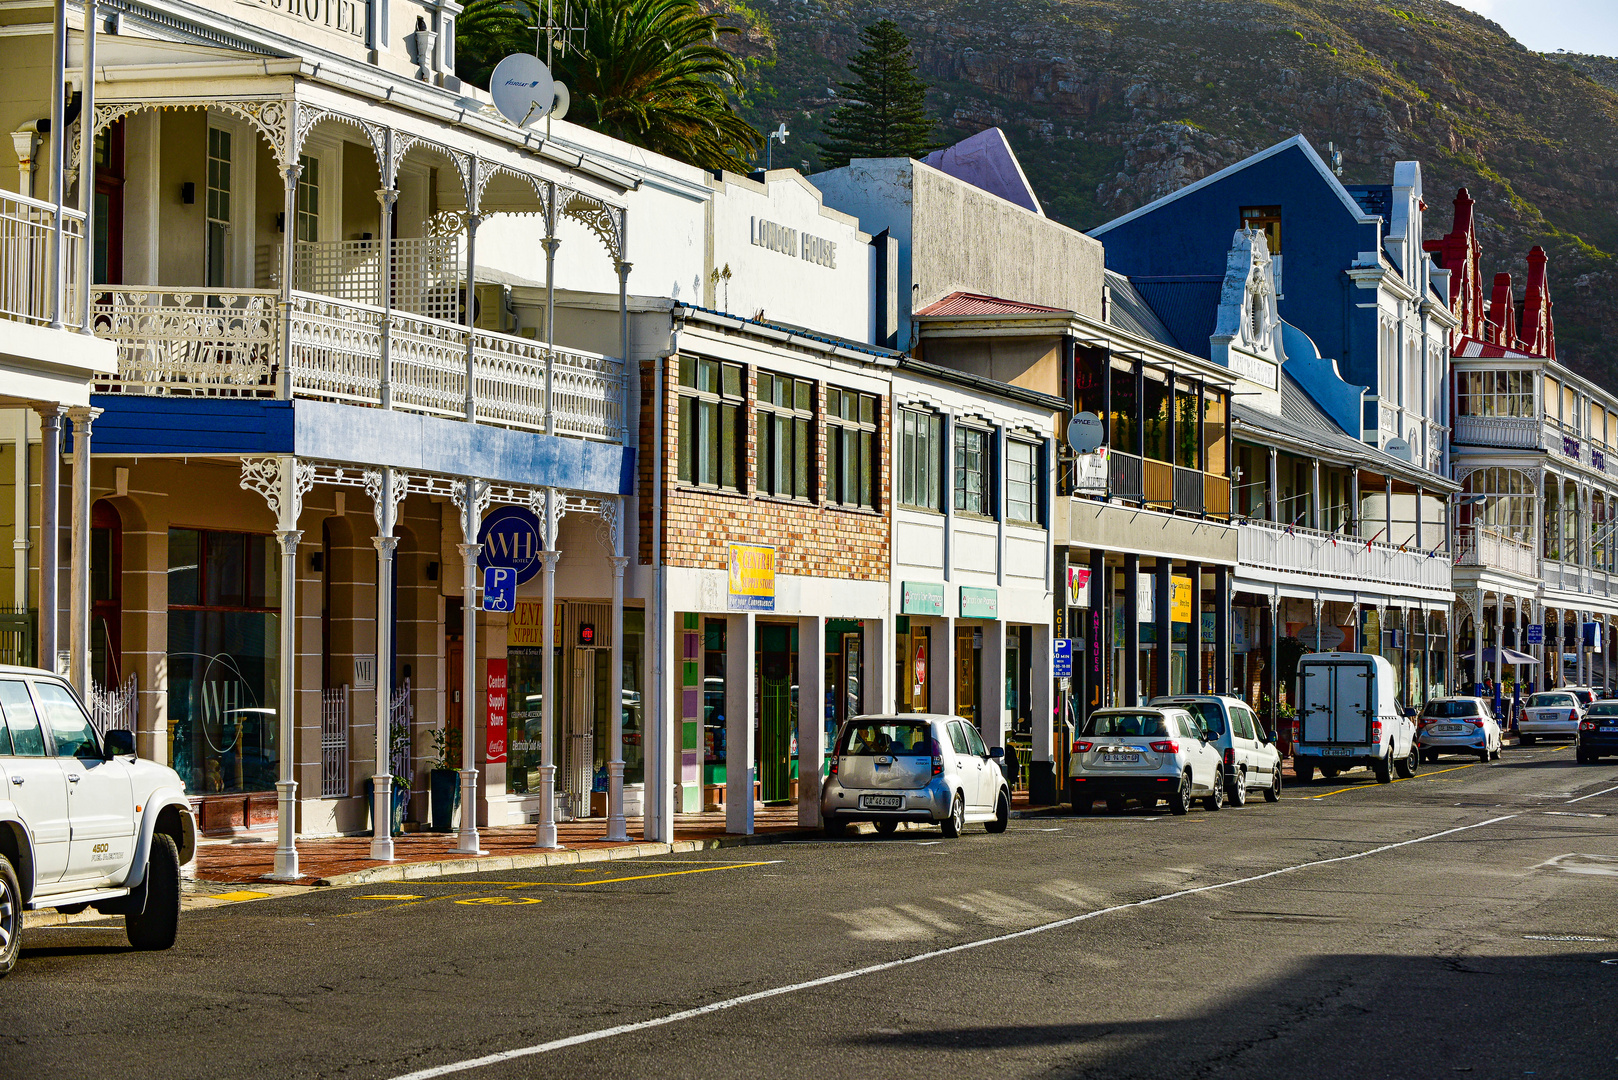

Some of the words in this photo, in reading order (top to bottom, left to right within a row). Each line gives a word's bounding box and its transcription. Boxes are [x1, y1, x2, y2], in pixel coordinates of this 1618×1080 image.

[751, 215, 798, 257] LONDON
[801, 232, 837, 269] HOUSE
[487, 532, 532, 558] WH
[742, 551, 774, 571] CENTRAL
[494, 569, 508, 588] P
[742, 577, 759, 589] SUPPLY
[760, 578, 774, 590] STORE
[513, 602, 561, 627] CENTL
[513, 628, 539, 643] SUPPLY
[1054, 640, 1067, 652] P
[355, 660, 371, 681] WH
[488, 674, 507, 688] Central
[202, 680, 239, 725] WH
[488, 693, 506, 711] Supply
[490, 712, 504, 727] Store
[512, 739, 529, 753] Electricity
[92, 842, 109, 853] 4500
